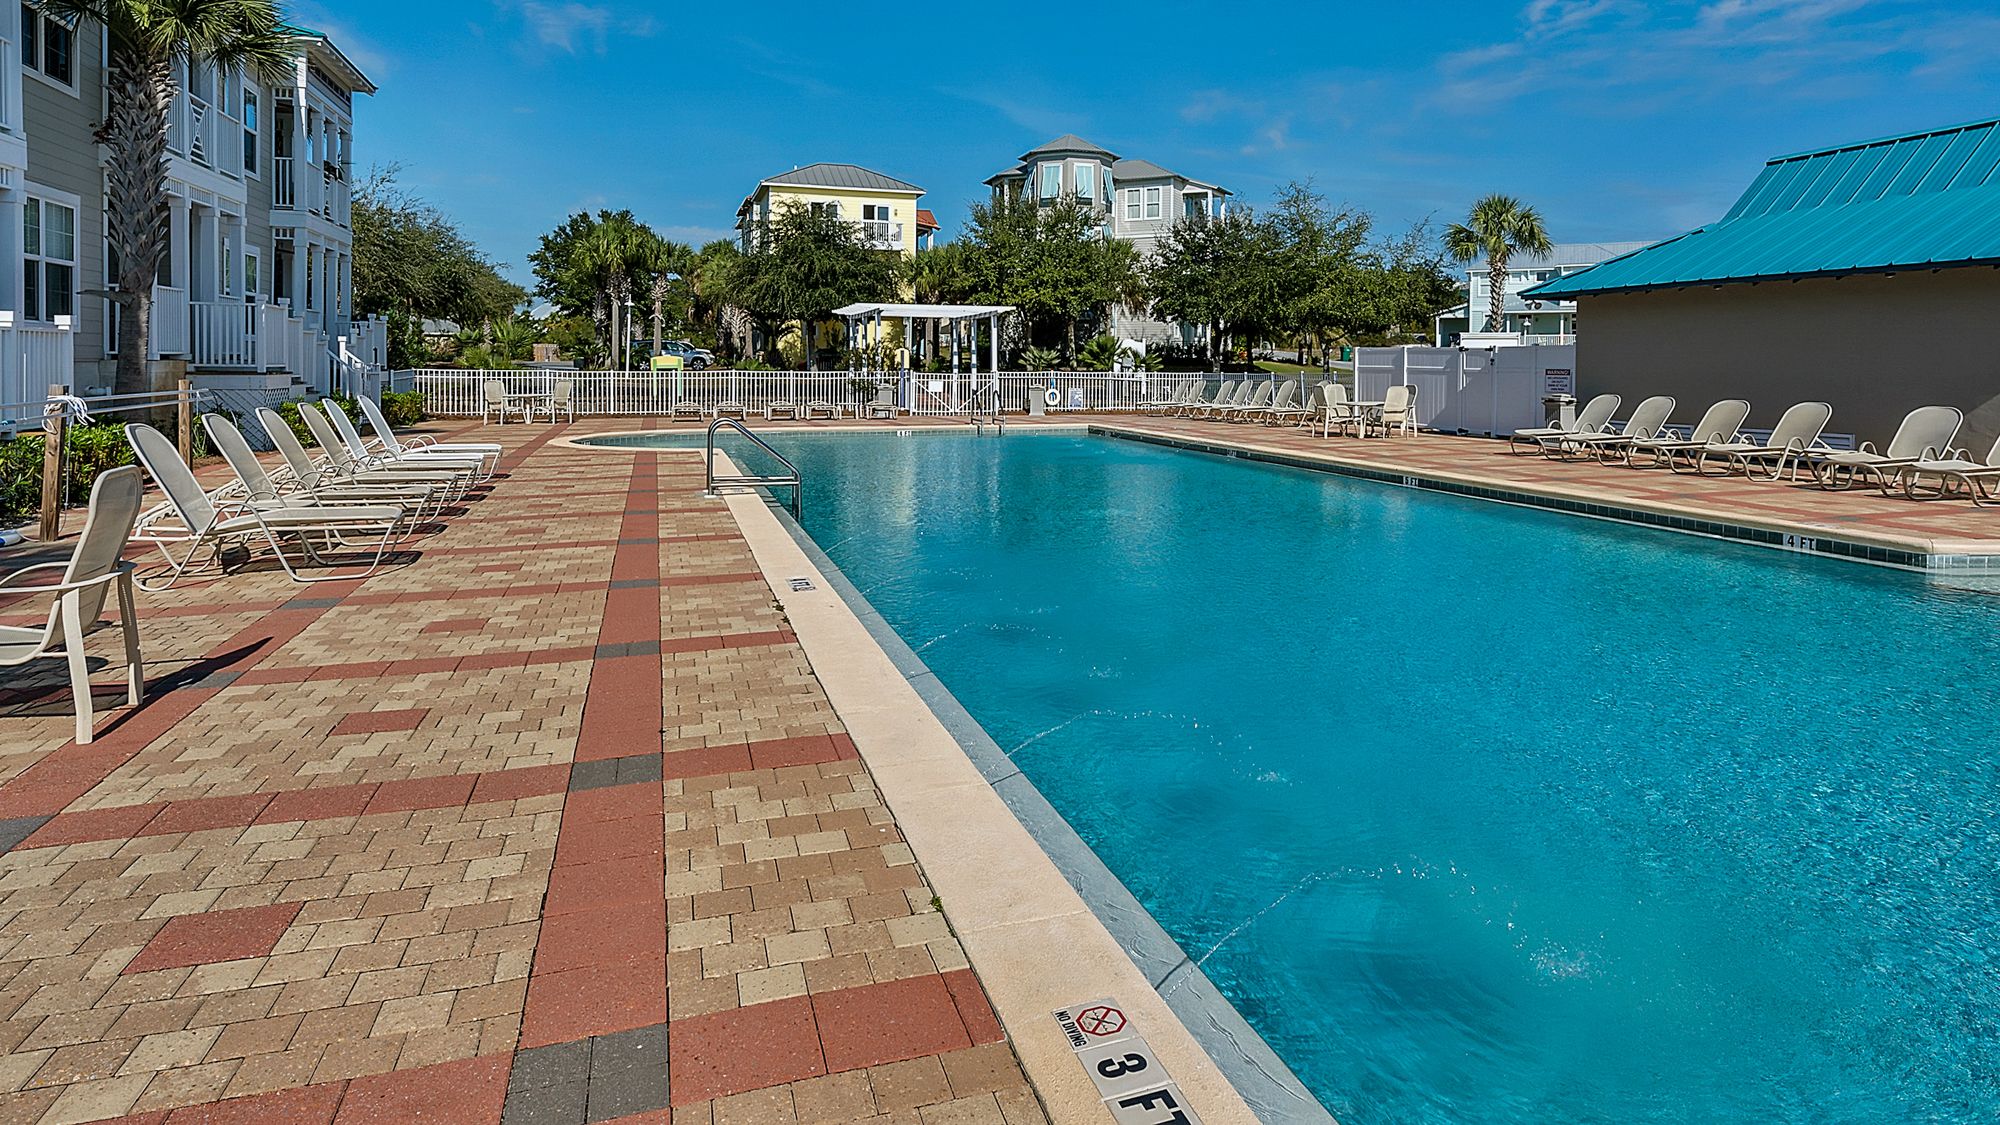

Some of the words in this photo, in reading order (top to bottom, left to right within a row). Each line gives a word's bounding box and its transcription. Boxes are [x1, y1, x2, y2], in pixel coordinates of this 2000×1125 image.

[1787, 535, 1795, 547] 4
[1054, 1010, 1071, 1022] NO
[1061, 1021, 1087, 1047] DIVING
[1097, 1053, 1147, 1078] 3
